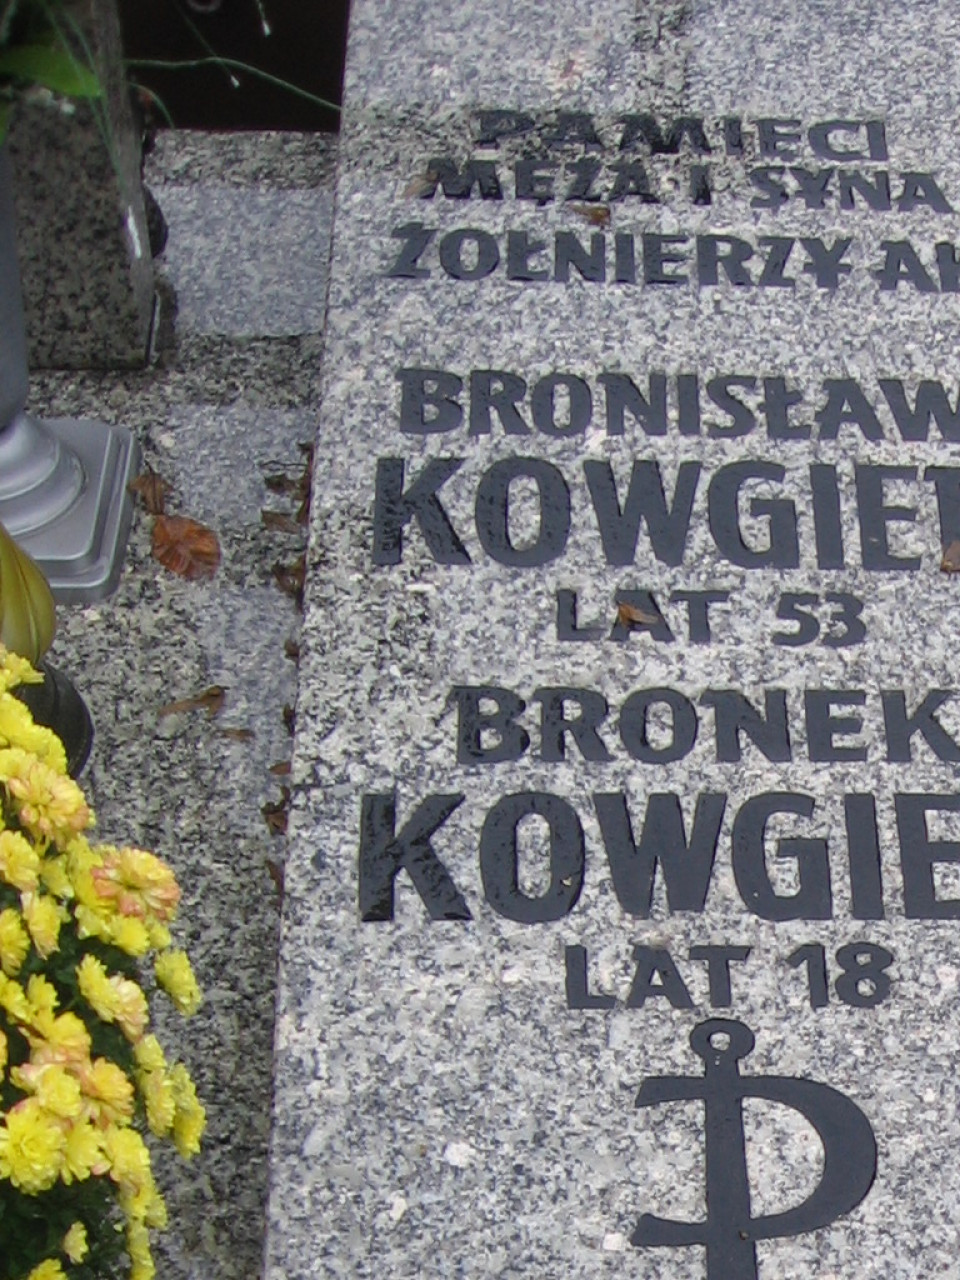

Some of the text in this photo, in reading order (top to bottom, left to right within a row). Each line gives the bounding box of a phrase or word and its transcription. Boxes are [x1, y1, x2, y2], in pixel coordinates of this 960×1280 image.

[689, 163, 713, 206] I
[748, 165, 956, 214] SYNA
[555, 589, 867, 646] LAT 53
[564, 941, 894, 1010] LAT 18
